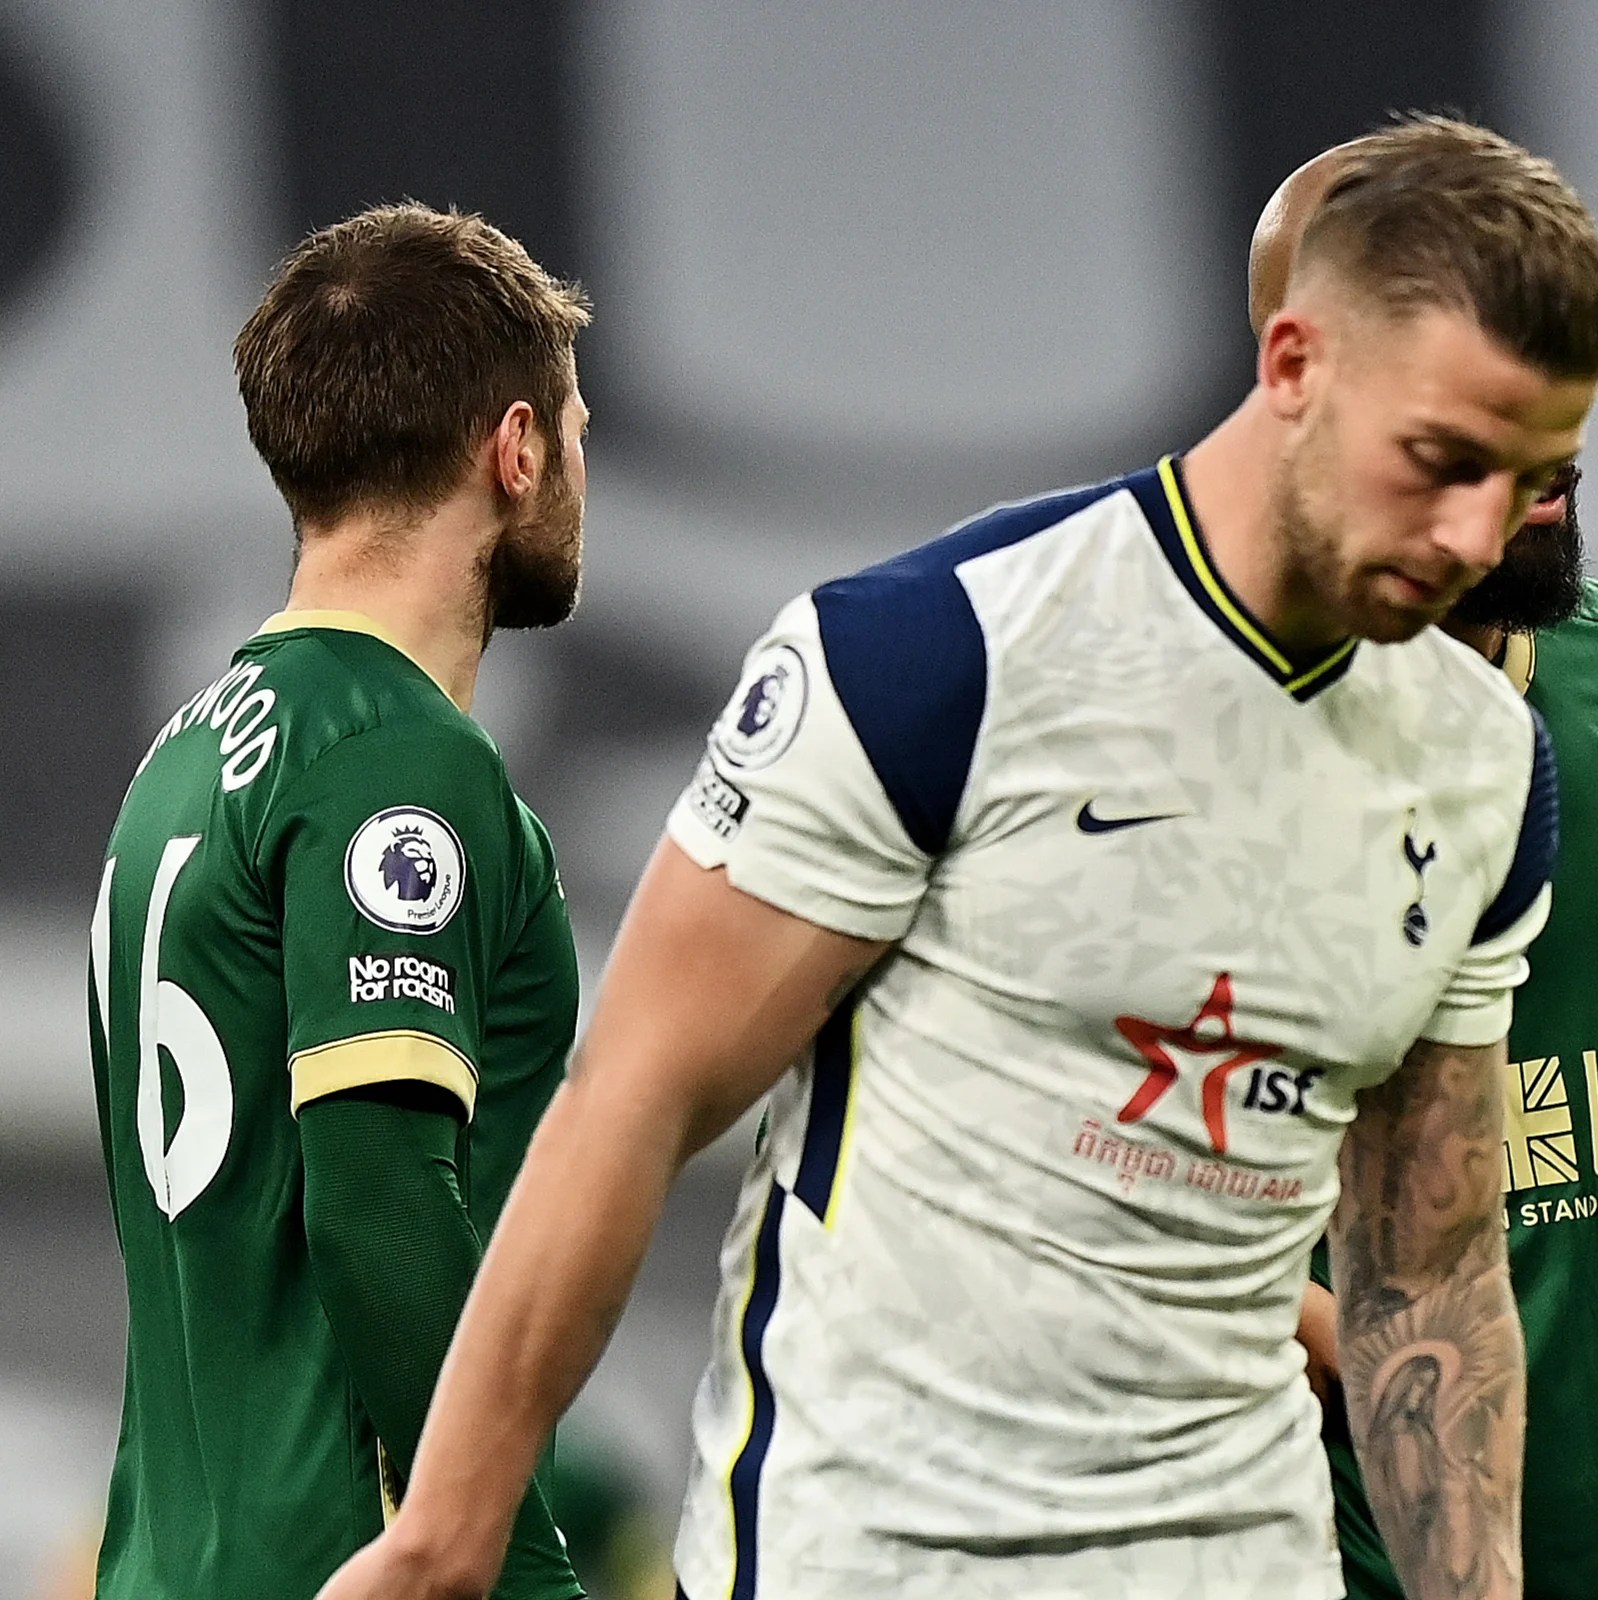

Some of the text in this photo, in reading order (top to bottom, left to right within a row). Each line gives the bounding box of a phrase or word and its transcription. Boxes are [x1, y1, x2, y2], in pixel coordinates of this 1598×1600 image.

[407, 873, 452, 920] Premier League
[349, 955, 448, 991] No room
[350, 978, 455, 1015] for racism
